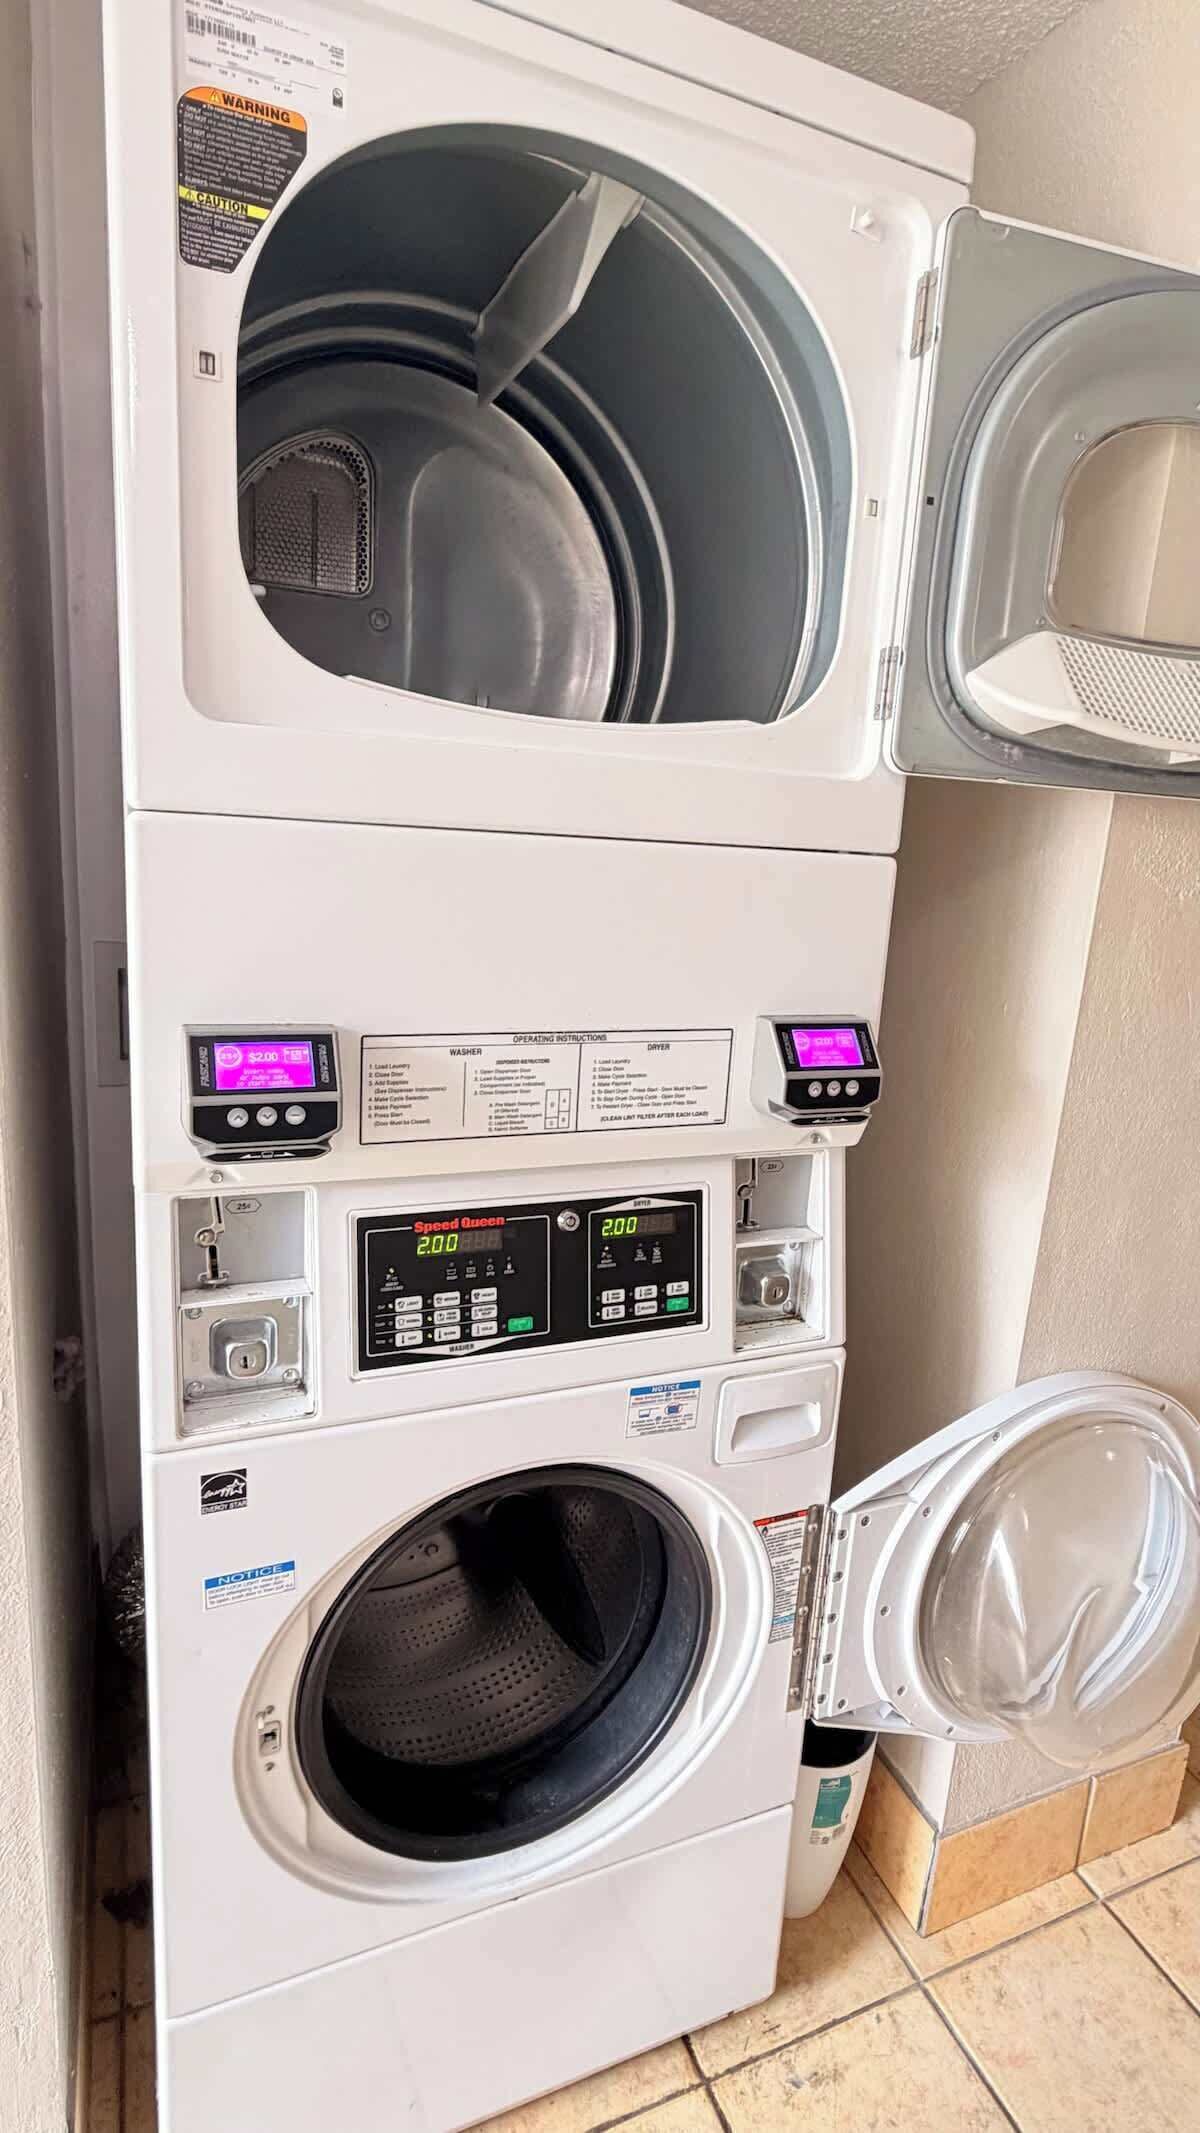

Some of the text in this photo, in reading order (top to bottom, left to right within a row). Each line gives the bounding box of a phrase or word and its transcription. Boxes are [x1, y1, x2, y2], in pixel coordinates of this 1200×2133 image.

[222, 93, 291, 123] WARNING
[197, 193, 248, 215] CAUTION
[513, 1034, 607, 1043] OPERATING INSTRUCTIONS
[450, 1048, 482, 1056] WASHER
[648, 1043, 670, 1051] DRYER
[249, 1052, 279, 1063] $2.00
[414, 1216, 506, 1234] Speed Queen
[601, 1216, 638, 1237] 2.00
[416, 1233, 459, 1256] 2.00
[449, 1344, 474, 1353] WASHER
[651, 1383, 681, 1392] NOTICE
[202, 1500, 248, 1514] ENERGY STAR
[218, 1564, 283, 1585] NOTICE
